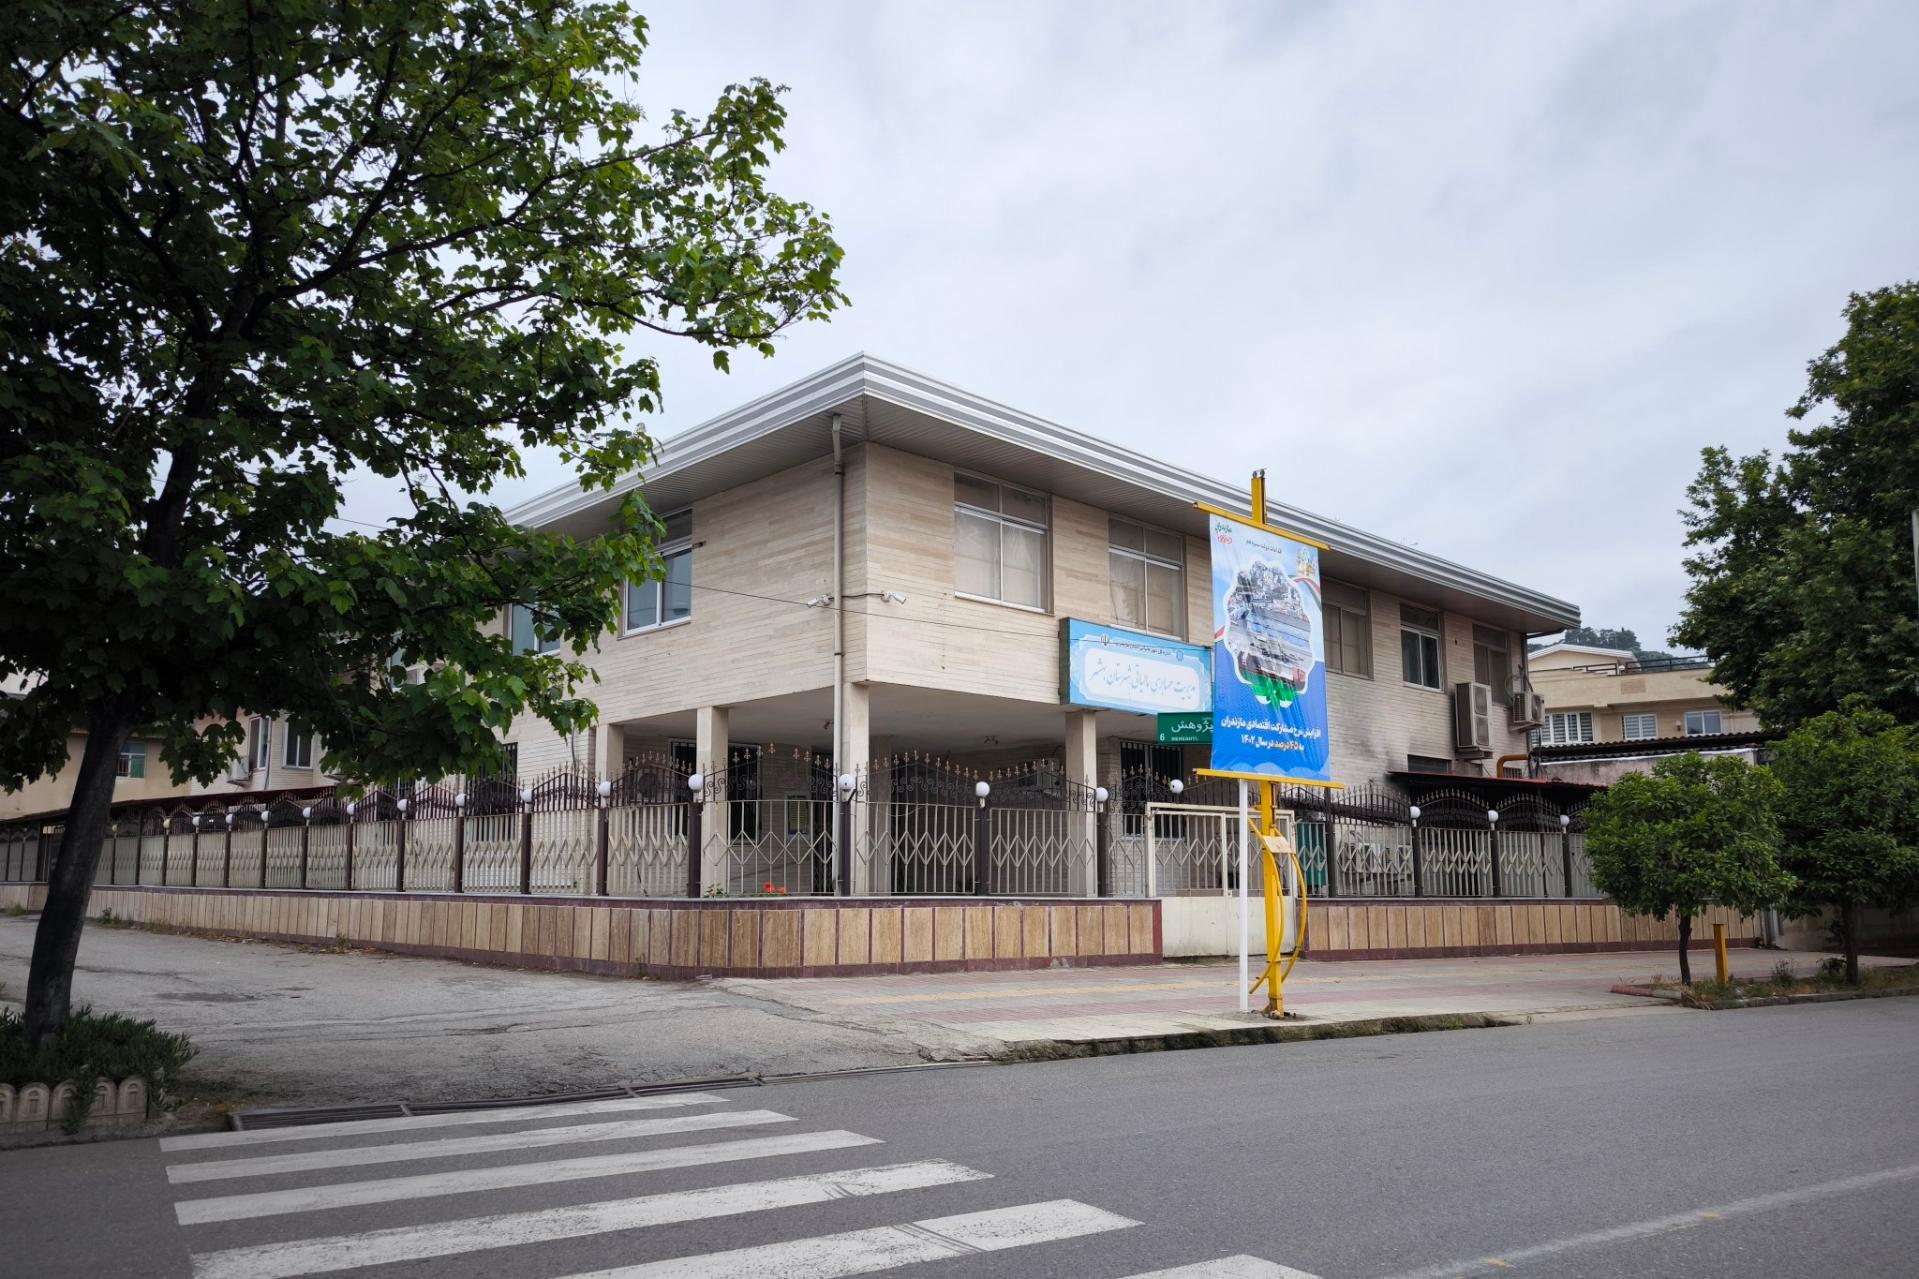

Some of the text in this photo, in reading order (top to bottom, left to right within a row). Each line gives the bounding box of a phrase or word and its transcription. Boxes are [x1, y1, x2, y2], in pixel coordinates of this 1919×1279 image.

[1106, 663, 1132, 687] شهرستان
[1131, 663, 1149, 693] مالیاتی
[1173, 681, 1196, 700] مدیریت
[1171, 719, 1214, 733] پژوهش
[1221, 716, 1321, 739] افزایش نرخ مشارکت اقتصادی مازندران
[1160, 733, 1165, 742] 6
[1241, 734, 1256, 745] ۱۴۰۲
[1255, 736, 1267, 748] سال
[1274, 740, 1290, 751] درصد
